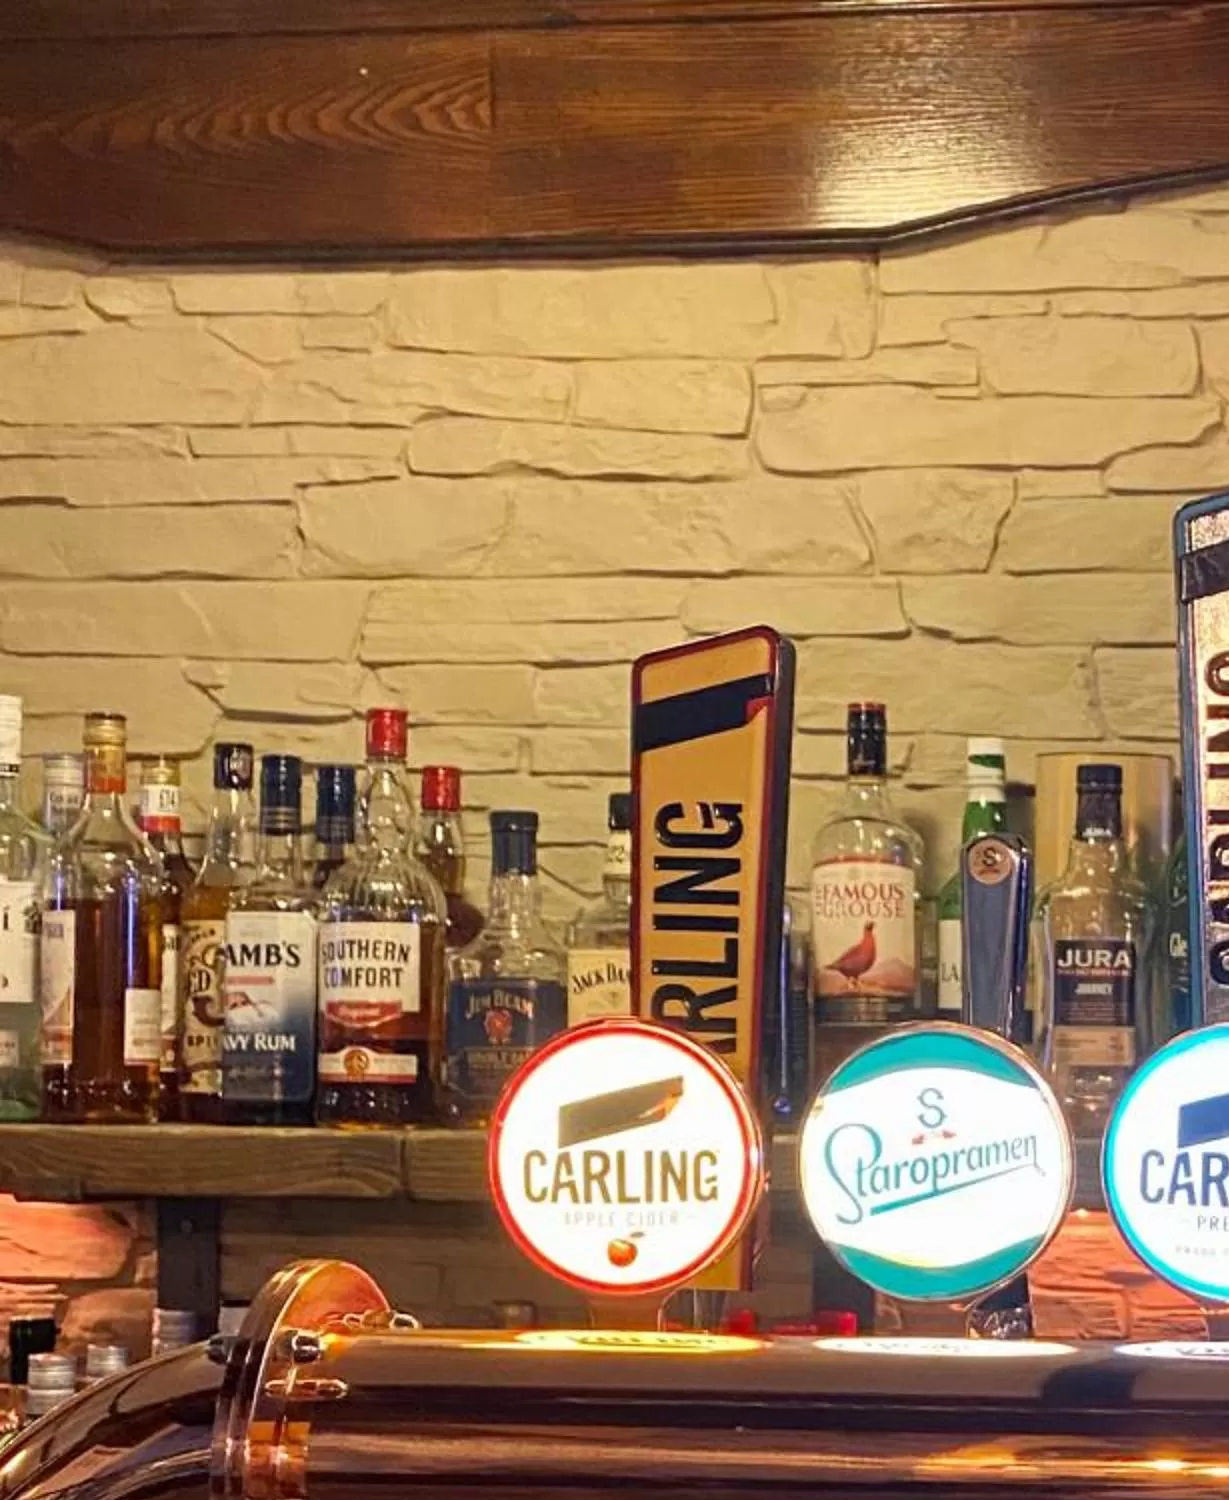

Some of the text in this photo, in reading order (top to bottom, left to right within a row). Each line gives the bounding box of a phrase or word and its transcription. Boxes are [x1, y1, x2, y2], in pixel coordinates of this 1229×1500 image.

[823, 881, 905, 901] FAMOUS
[823, 901, 905, 919] GROUSE
[651, 801, 744, 1056] RLING
[225, 941, 301, 968] AMB'S
[321, 939, 412, 964] SOUTHERN
[1057, 948, 1132, 969] JURA
[323, 966, 404, 989] COMFORT
[222, 1031, 297, 1051] AVY RUM
[916, 1088, 947, 1129] S
[522, 1148, 720, 1205] CARLING
[824, 1122, 1047, 1225] Staropramen
